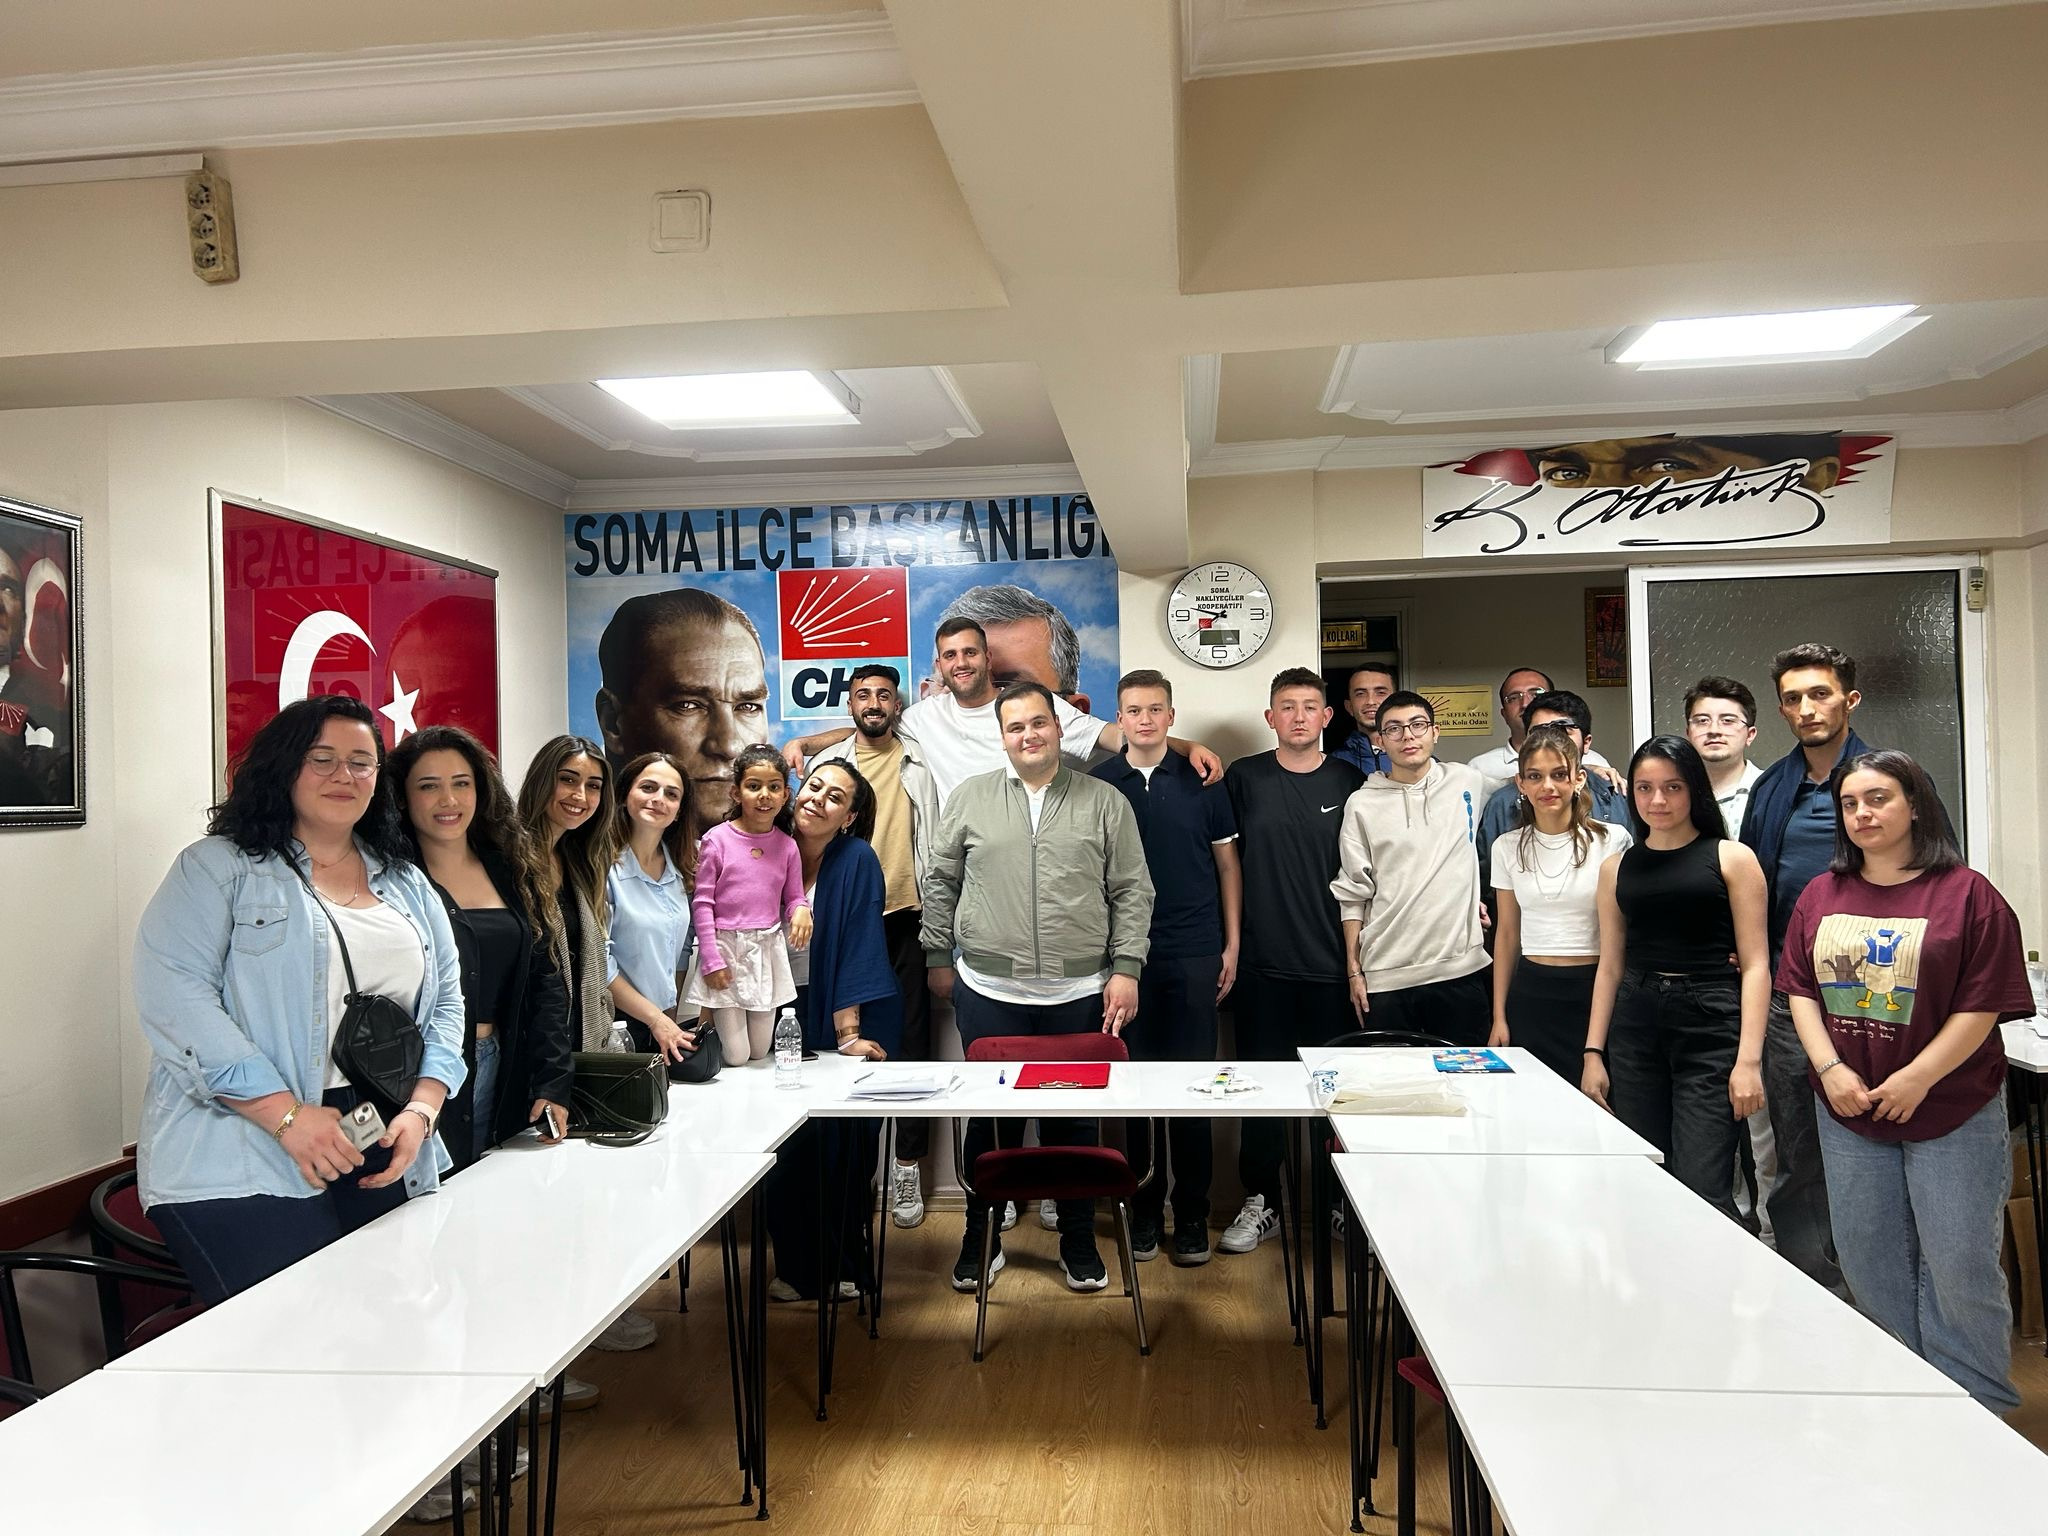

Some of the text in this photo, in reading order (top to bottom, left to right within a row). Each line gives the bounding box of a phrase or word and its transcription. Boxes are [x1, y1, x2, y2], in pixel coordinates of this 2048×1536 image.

[574, 511, 703, 577] SOMA
[717, 507, 815, 572] İLÇE
[1211, 570, 1230, 582] 12
[1175, 609, 1190, 622] 9
[1250, 608, 1265, 621] 3
[1326, 630, 1358, 642] KOLLARI
[1211, 645, 1228, 659] 6
[791, 666, 900, 708] CH
